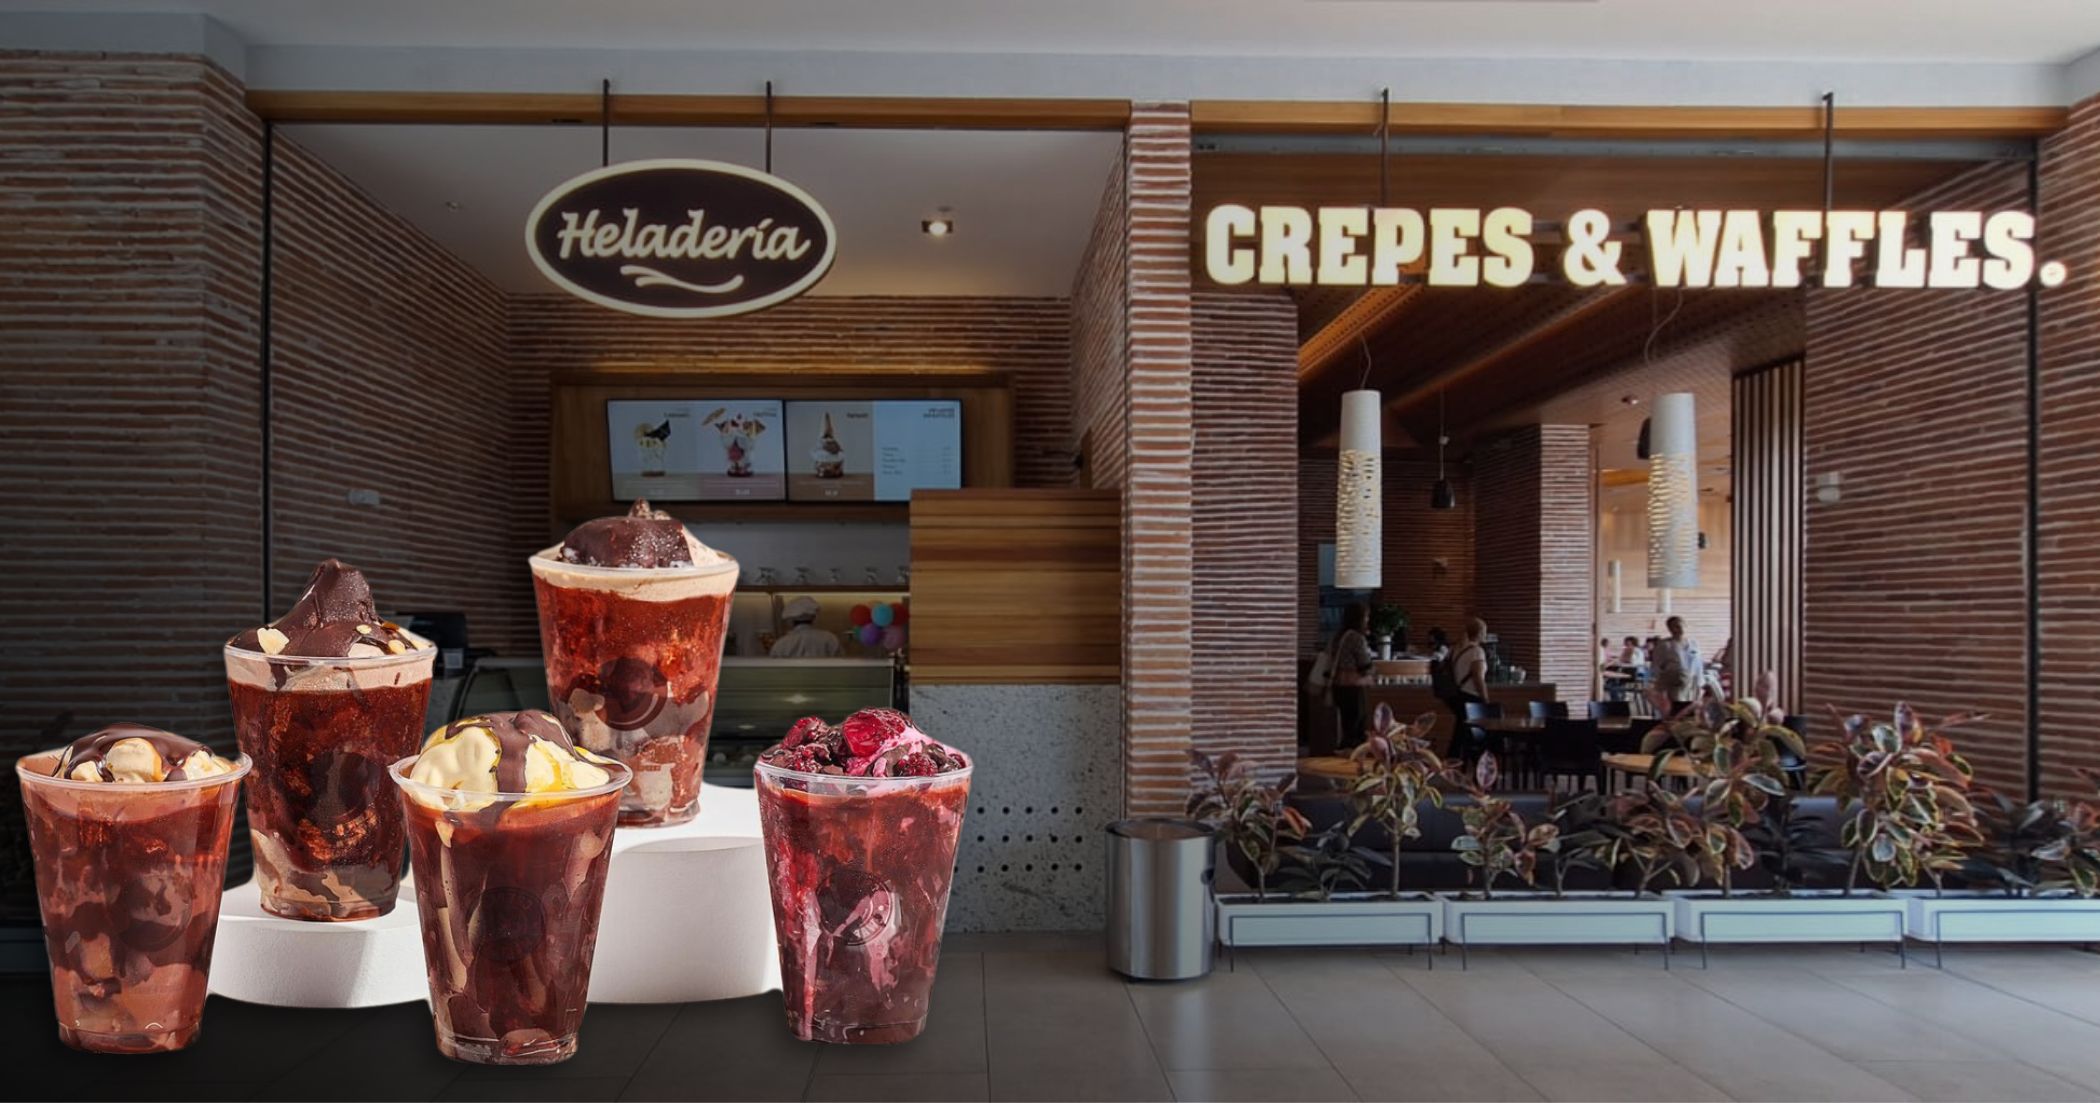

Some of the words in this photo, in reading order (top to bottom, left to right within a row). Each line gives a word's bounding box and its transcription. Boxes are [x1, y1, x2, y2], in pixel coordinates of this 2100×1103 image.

[557, 208, 811, 261] Heladería
[1205, 204, 1533, 288] CREPES
[1565, 207, 1625, 287] &
